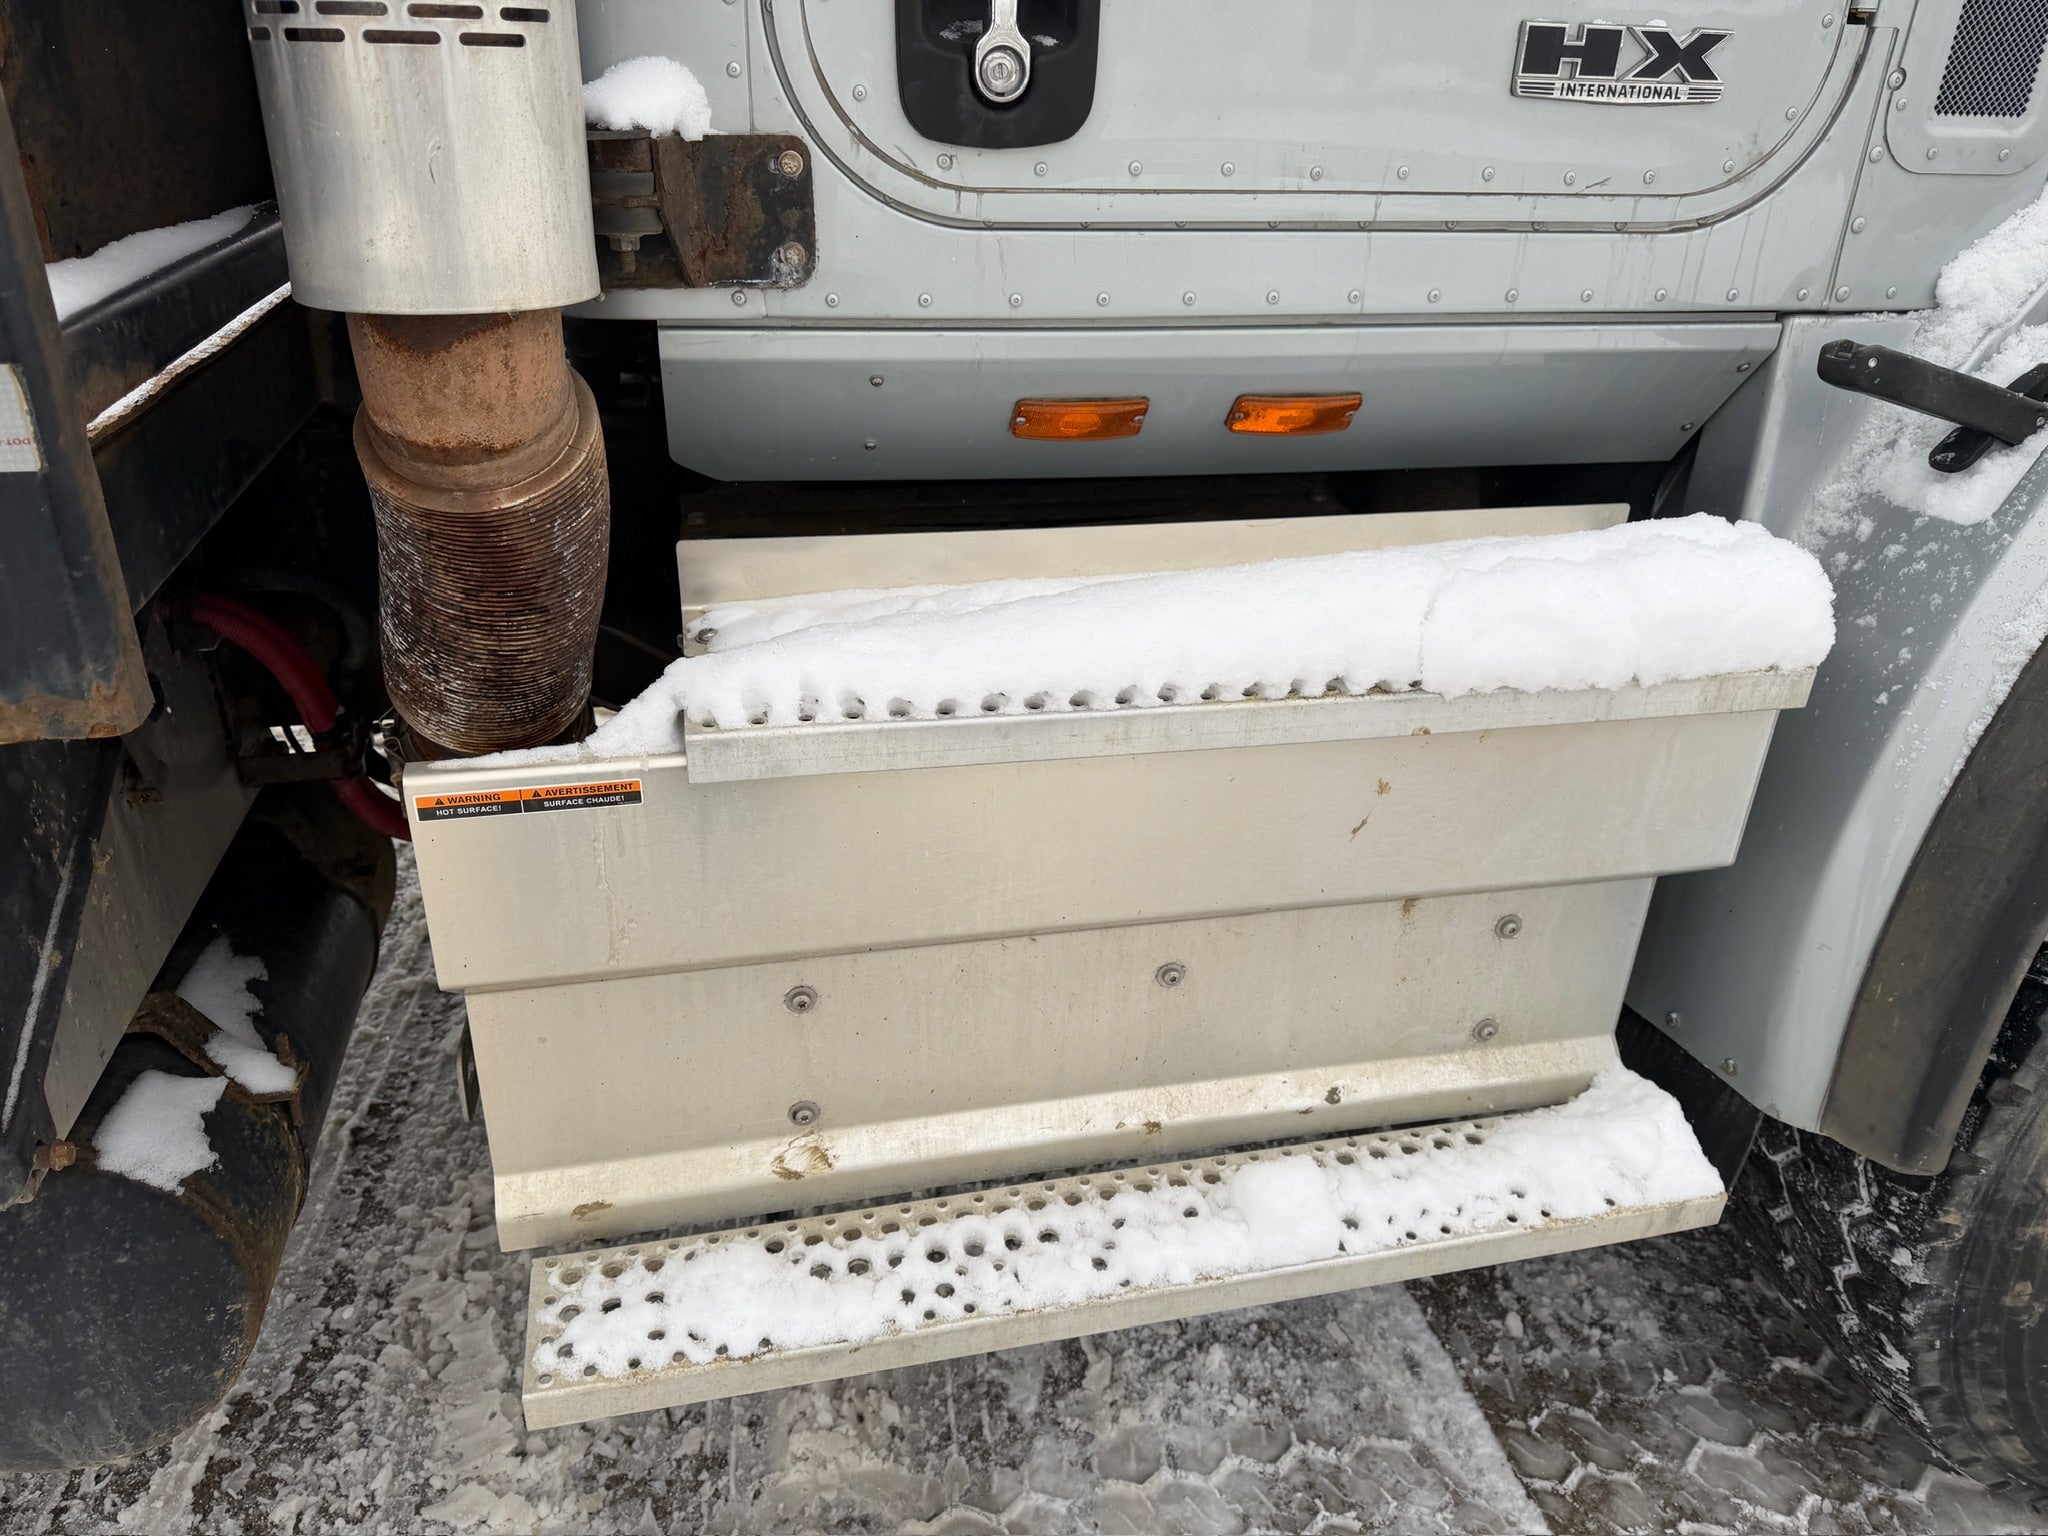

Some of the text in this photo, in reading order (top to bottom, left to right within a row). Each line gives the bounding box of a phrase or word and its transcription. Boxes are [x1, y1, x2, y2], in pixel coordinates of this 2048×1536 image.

[1517, 21, 1734, 83] HX
[1559, 83, 1682, 100] INTERNATIONAL
[0, 438, 31, 446] DOT-
[545, 783, 634, 797] AVERTISSEMENT
[447, 793, 501, 805] WARNING
[543, 798, 583, 808] SURFACE
[586, 795, 625, 804] CHAUDE!
[436, 804, 502, 816] HOT SURFACE!
